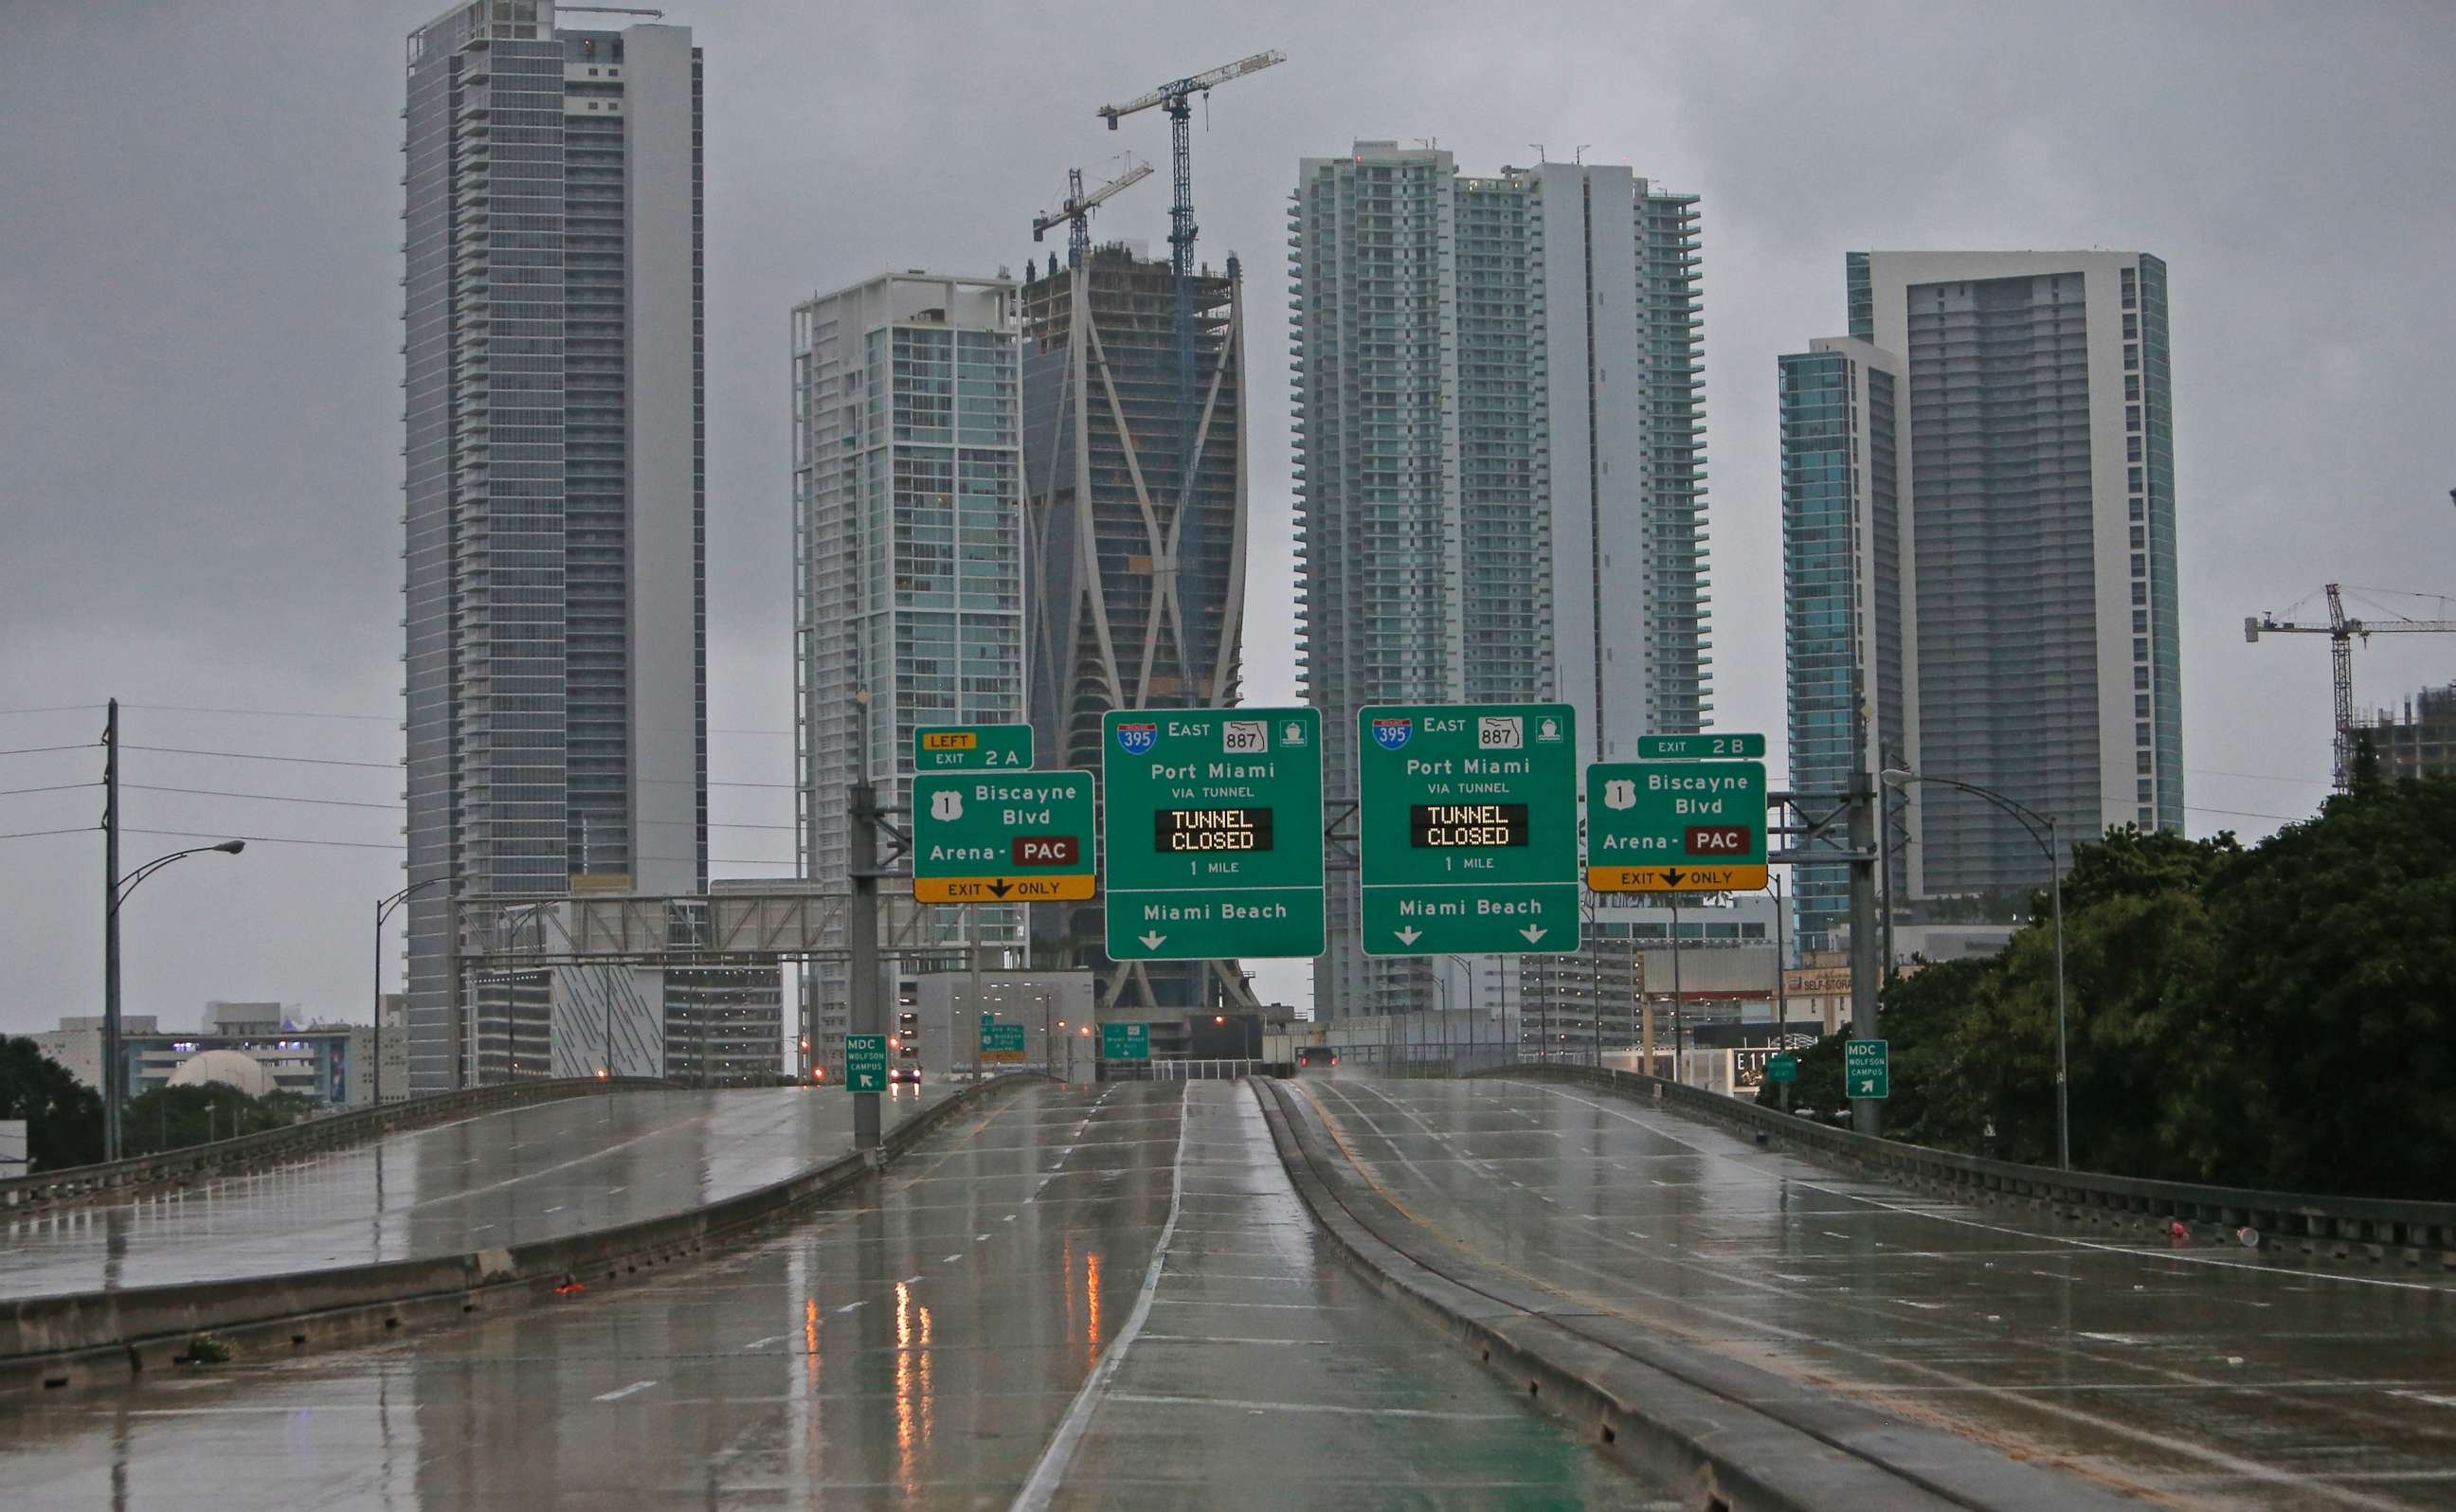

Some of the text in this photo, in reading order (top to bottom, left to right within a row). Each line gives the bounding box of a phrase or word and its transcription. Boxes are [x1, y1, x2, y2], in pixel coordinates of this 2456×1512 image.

[930, 734, 968, 747] LEFT
[1124, 731, 1150, 747] 395
[1227, 733, 1255, 747] 887
[1379, 727, 1406, 743] 395
[1482, 729, 1510, 744] 887
[1659, 742, 1686, 752] EXIT
[936, 753, 964, 764] EXIT
[1152, 763, 1273, 779] Port Miami
[1407, 758, 1529, 775] Port Miami
[1428, 783, 1509, 794] VIA TUNNEL
[1649, 775, 1747, 793] Biscayne
[976, 785, 1075, 803] Biscayne
[1172, 787, 1255, 799] VIA TUNNEL
[1617, 786, 1621, 802] 1
[944, 797, 948, 814] 1
[1676, 799, 1722, 814] Blvd
[1003, 809, 1049, 824] Blvd
[1172, 810, 1253, 828] TUNNEL
[1428, 806, 1508, 824] TUNNEL
[1173, 832, 1253, 850] CLOSED
[1428, 827, 1508, 845] CLOSED
[1697, 833, 1737, 848] PAC
[1025, 843, 1065, 858] PAC
[1191, 861, 1238, 875] 1 MILE
[1446, 856, 1493, 871] 1 MILE
[1622, 872, 1733, 885] EXIT ONLY
[948, 882, 1060, 896] EXIT ONLY
[1145, 903, 1286, 920] Miami Beach
[1400, 899, 1541, 915] Miami Beach
[848, 1038, 876, 1050] MDC
[1849, 1045, 1876, 1055] MDC
[851, 1062, 882, 1071] CAMPUS
[1850, 1057, 1885, 1066] WOLFSON
[1851, 1068, 1883, 1076] CAMPUS
